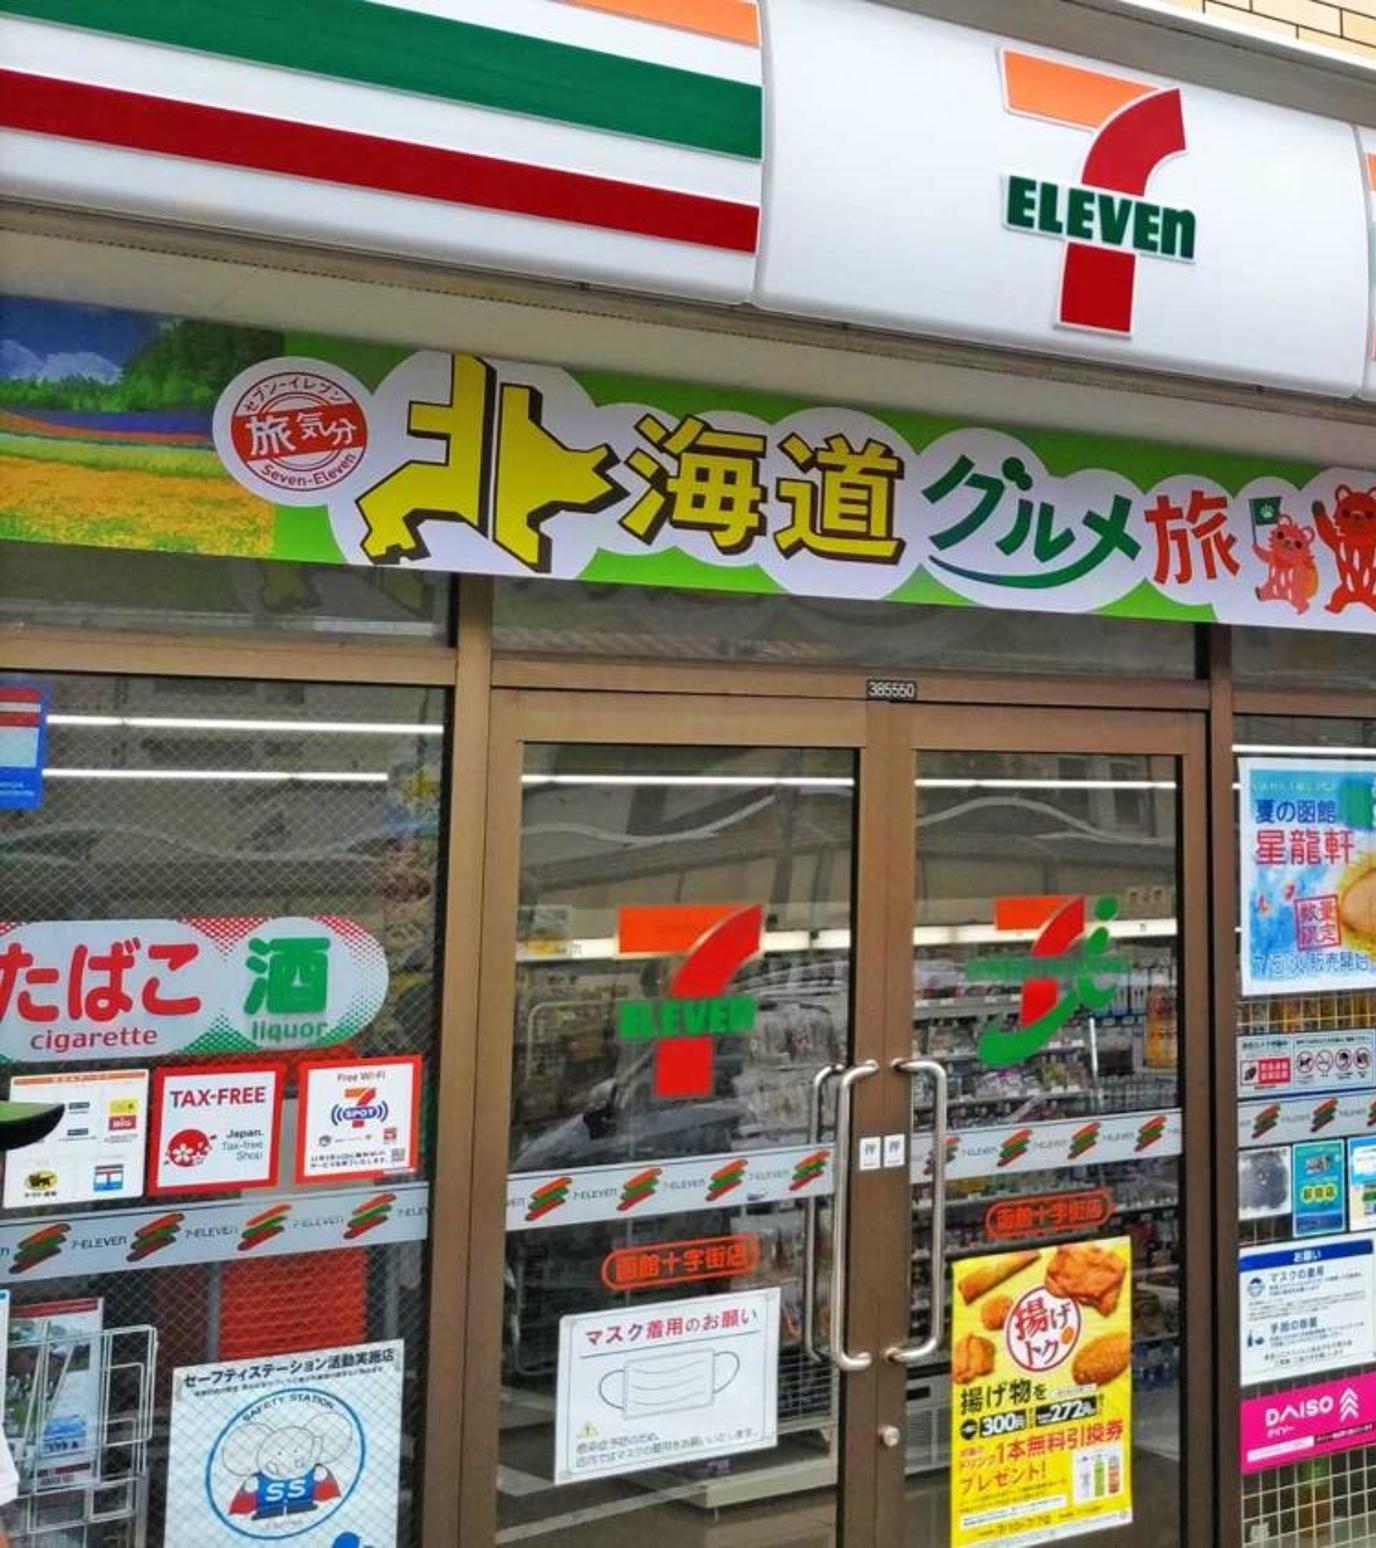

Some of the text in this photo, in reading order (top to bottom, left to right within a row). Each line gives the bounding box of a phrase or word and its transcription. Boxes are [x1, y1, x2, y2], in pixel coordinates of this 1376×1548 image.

[1003, 49, 1187, 334] 7
[245, 411, 357, 456] 旅気分
[261, 453, 356, 486] Seven-Eleven
[1256, 829, 1354, 866] 星龍軒
[0, 937, 331, 1023] たばこ 酒
[30, 1019, 328, 1051] cigarette liquor
[337, 1073, 358, 1082] Free
[170, 1086, 267, 1108] TAX-FREE
[344, 1108, 376, 1119] SPOT
[222, 1139, 264, 1153] Tax-free
[236, 1150, 264, 1163] Shop
[585, 1307, 760, 1347] マスク着用のお願い
[1015, 1297, 1072, 1341] 揚げ
[184, 1347, 395, 1388] セーフティステーション活動実施店
[960, 1378, 1048, 1415] 揚げ物を
[1265, 1395, 1335, 1427] DAISO
[265, 1480, 307, 1502] SS
